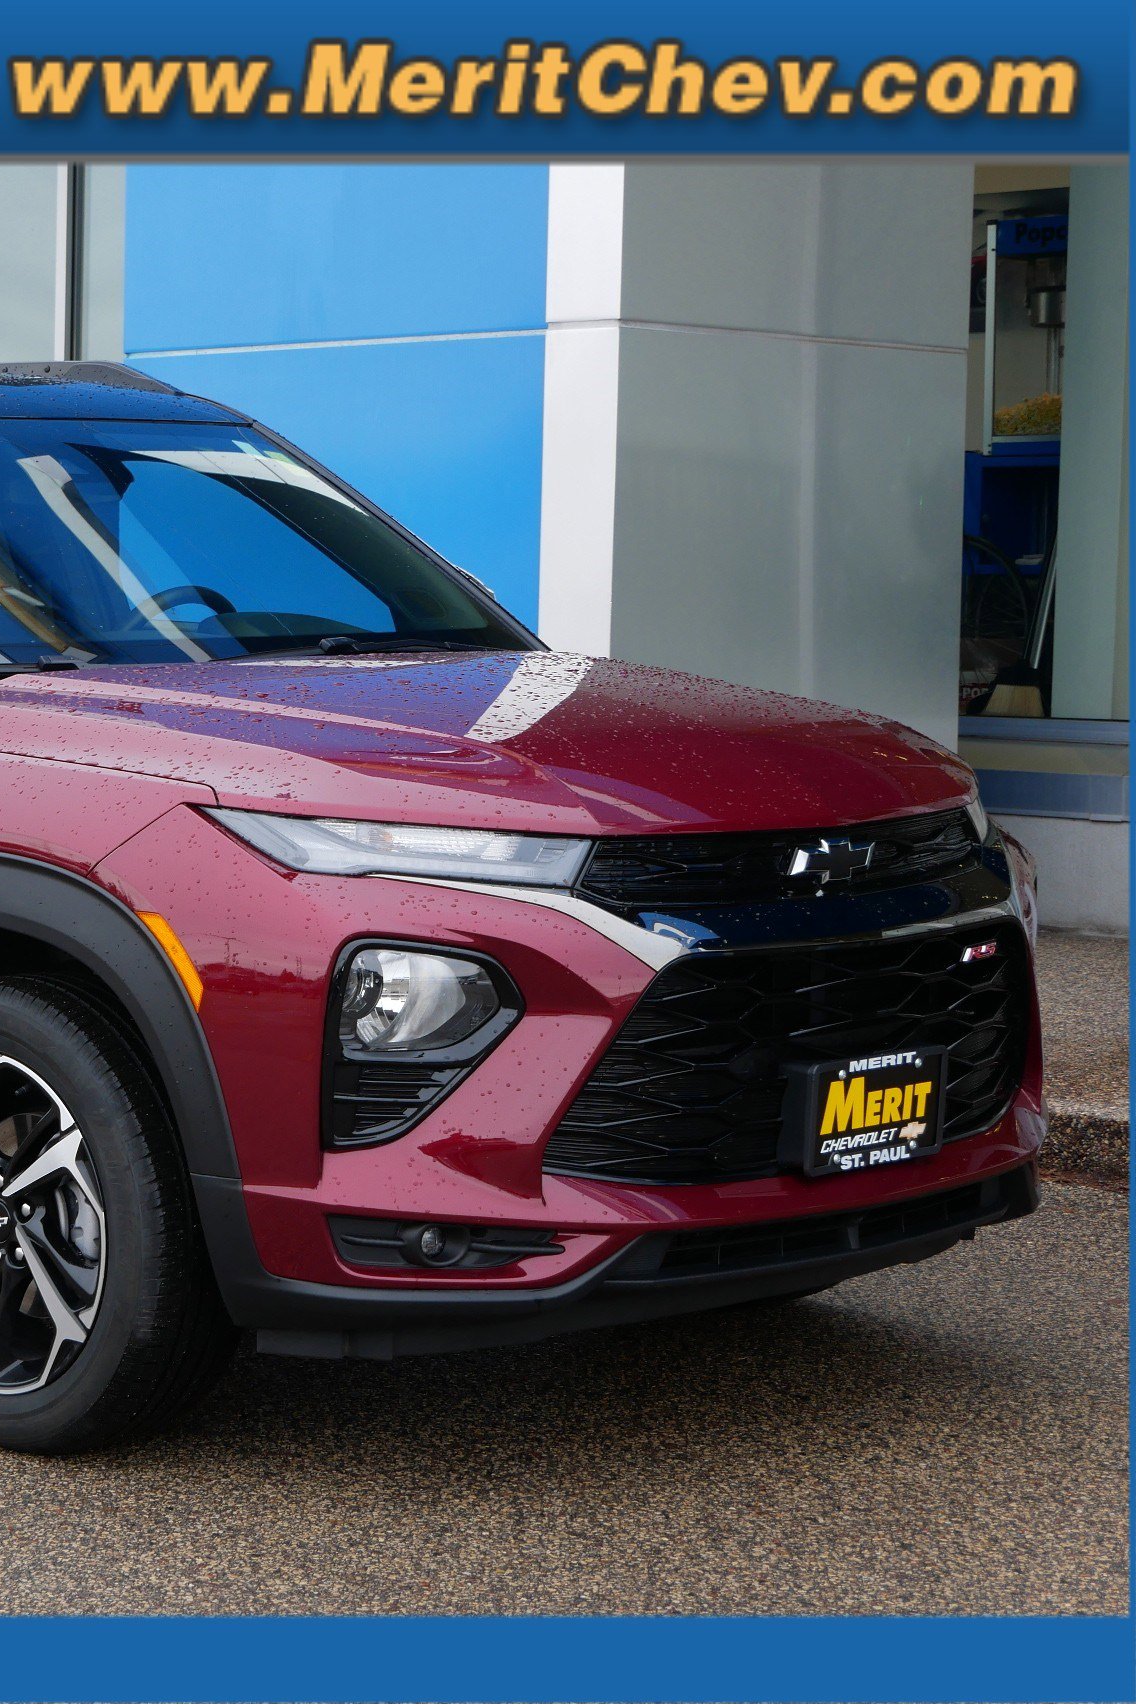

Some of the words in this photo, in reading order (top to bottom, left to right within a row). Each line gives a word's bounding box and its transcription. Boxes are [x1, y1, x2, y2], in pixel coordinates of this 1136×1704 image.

[849, 1052, 916, 1073] MERIT
[820, 1076, 932, 1136] MERIT
[820, 1127, 898, 1154] CHEVROLET
[840, 1153, 864, 1171] ST.
[869, 1145, 911, 1165] PAUL
